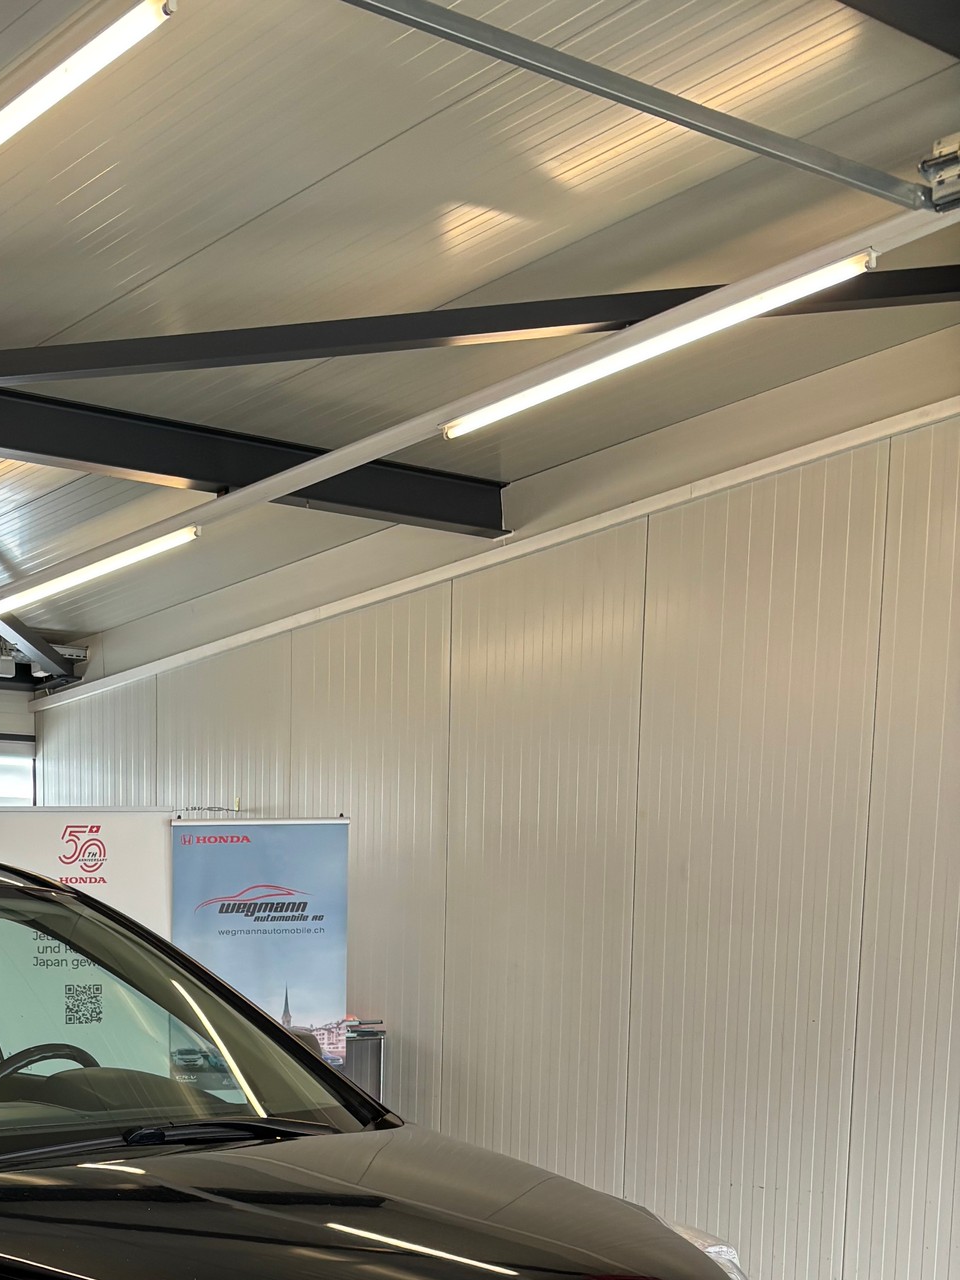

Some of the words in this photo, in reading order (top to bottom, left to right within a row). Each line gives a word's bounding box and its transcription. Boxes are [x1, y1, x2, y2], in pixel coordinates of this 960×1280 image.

[196, 835, 251, 844] HONDA
[59, 876, 107, 884] HONDA
[218, 901, 308, 917] wegmann
[218, 927, 325, 937] wegmannautomobile.ch
[37, 943, 60, 954] und
[32, 956, 68, 969] Japan
